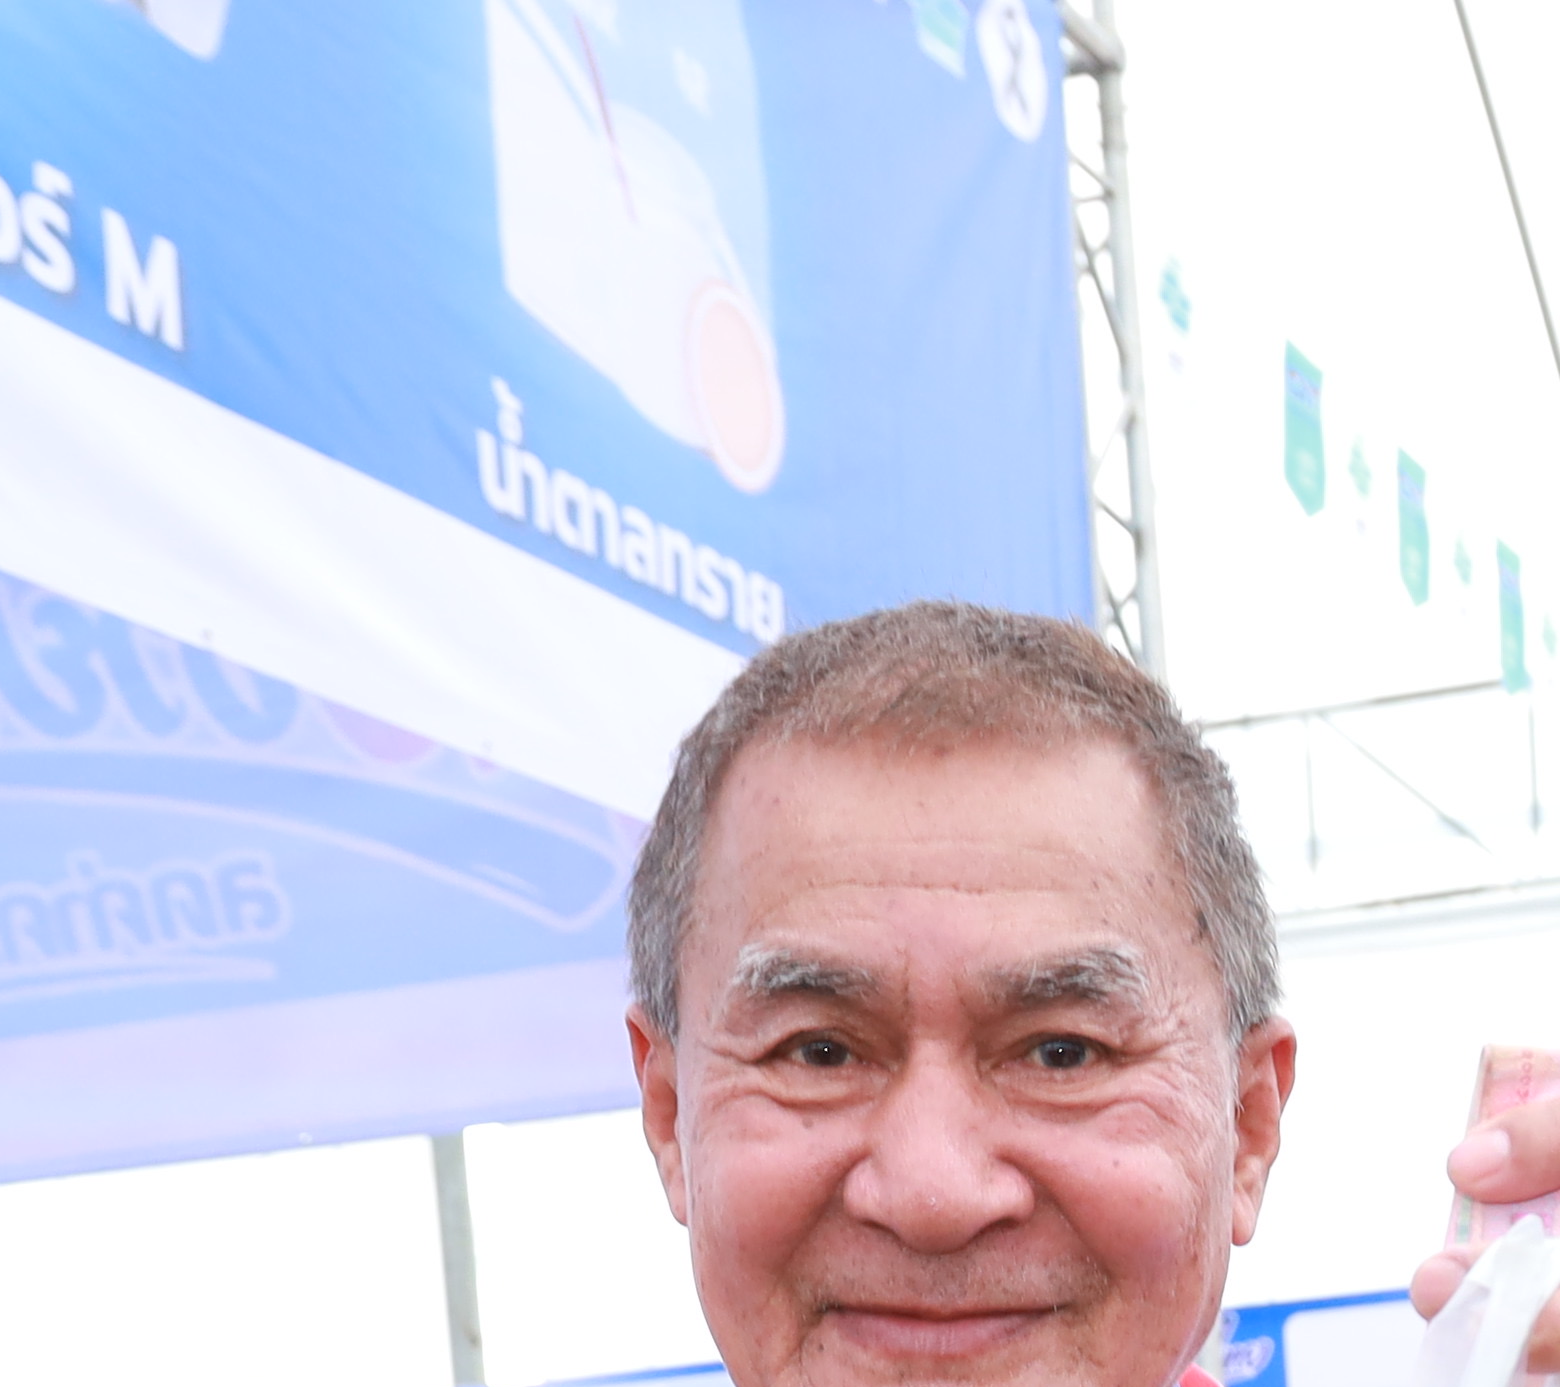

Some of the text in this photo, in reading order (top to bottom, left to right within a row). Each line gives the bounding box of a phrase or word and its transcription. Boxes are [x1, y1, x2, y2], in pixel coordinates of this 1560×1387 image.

[102, 206, 186, 352] M
[473, 374, 787, 645] น้ำตาลทราย
